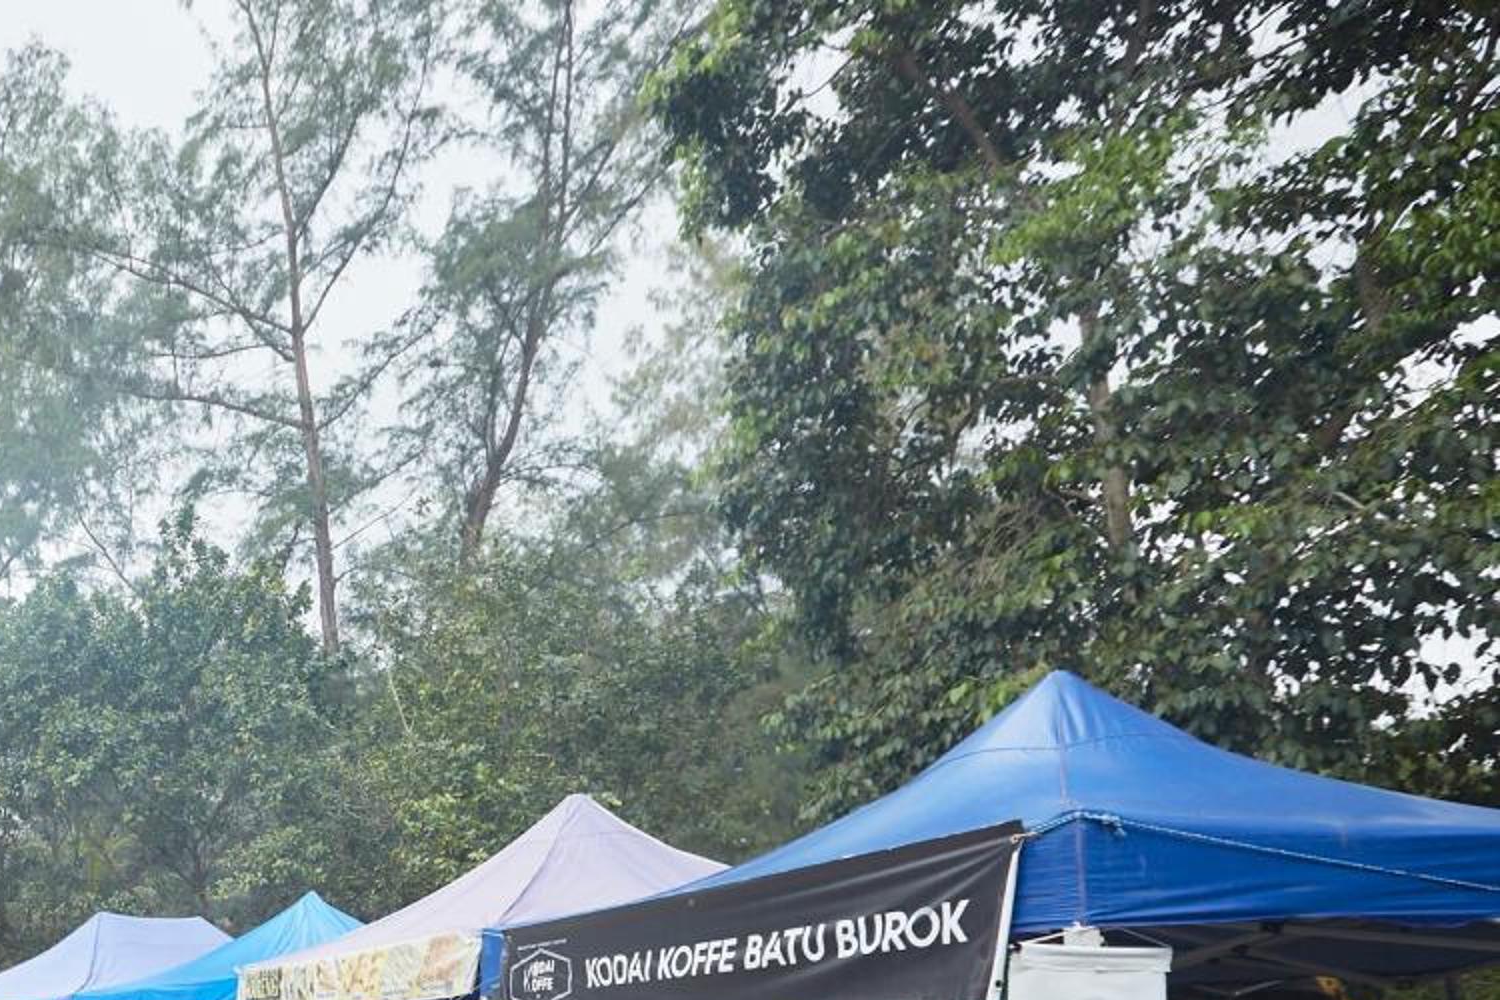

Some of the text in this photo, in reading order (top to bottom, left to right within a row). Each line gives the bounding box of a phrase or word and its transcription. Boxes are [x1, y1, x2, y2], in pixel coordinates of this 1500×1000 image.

[585, 898, 970, 988] KODAI KOFFE BATU BUROK
